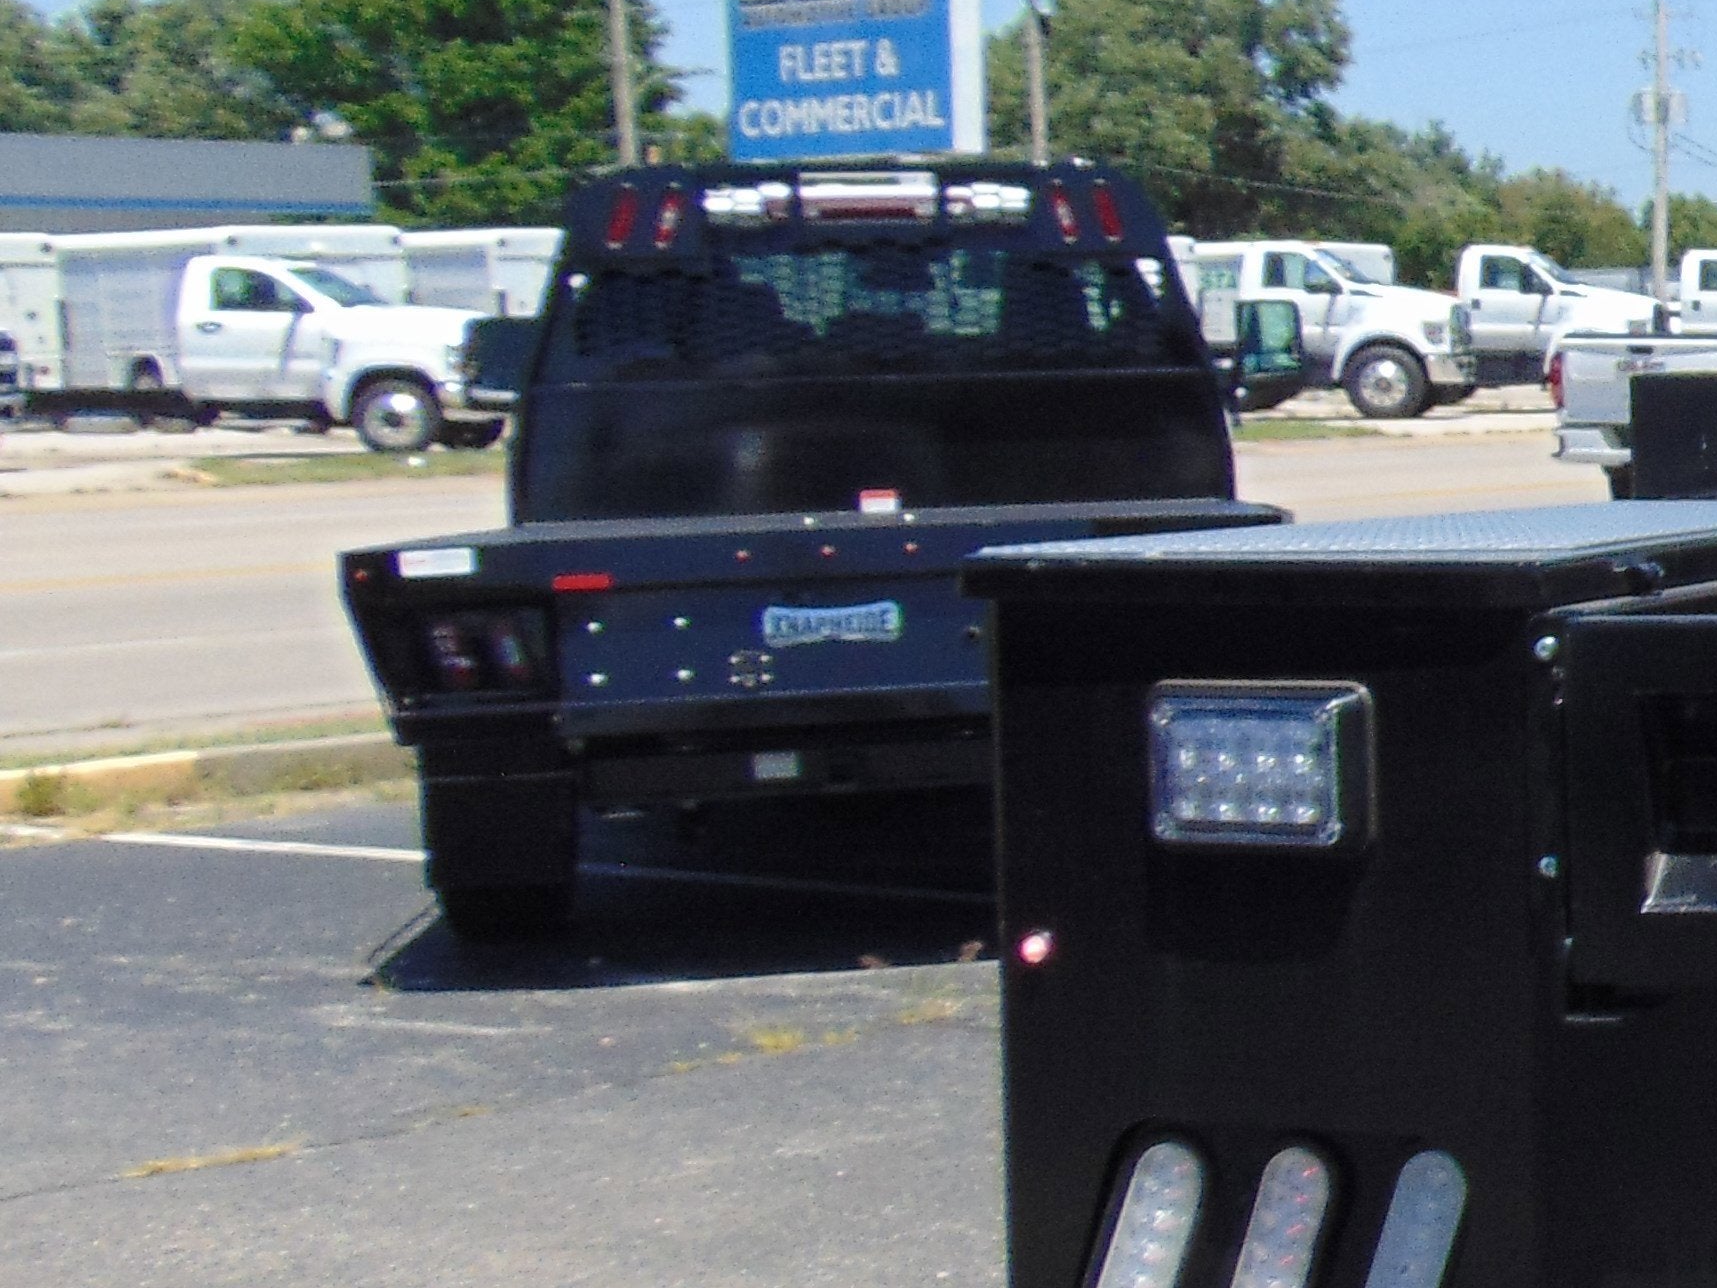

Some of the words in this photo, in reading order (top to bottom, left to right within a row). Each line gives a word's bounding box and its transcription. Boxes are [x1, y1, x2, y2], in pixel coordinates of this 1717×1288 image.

[779, 40, 869, 82] FLEET
[876, 38, 900, 77] &
[739, 90, 945, 137] COMMERCIAL
